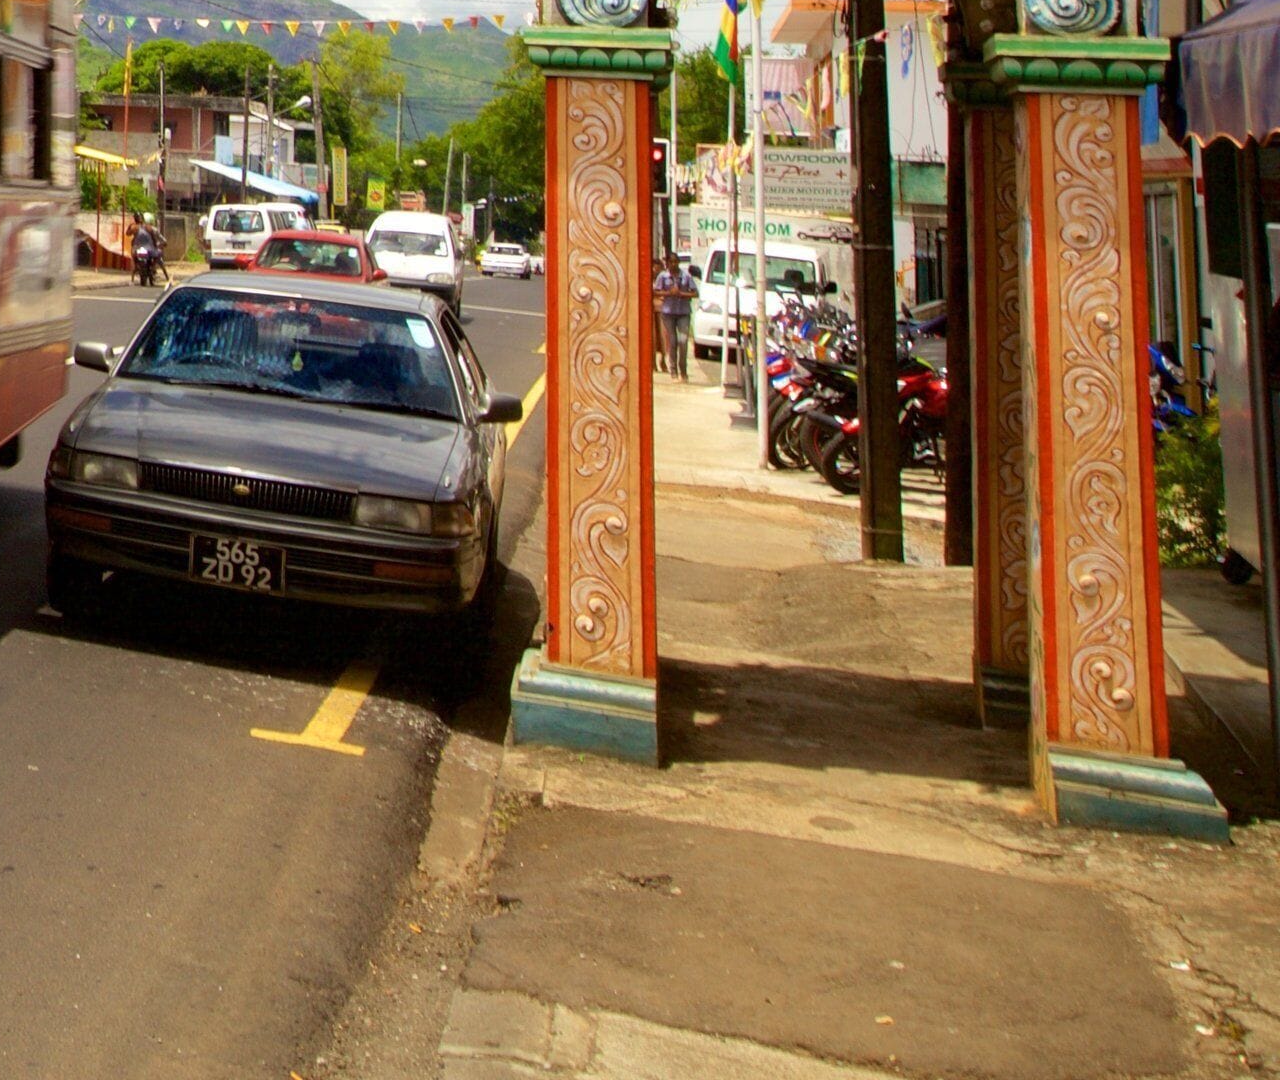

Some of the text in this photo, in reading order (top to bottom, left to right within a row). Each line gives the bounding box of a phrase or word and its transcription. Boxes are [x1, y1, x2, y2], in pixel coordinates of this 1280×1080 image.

[216, 538, 260, 567] 565
[201, 556, 272, 592] ZD 92
